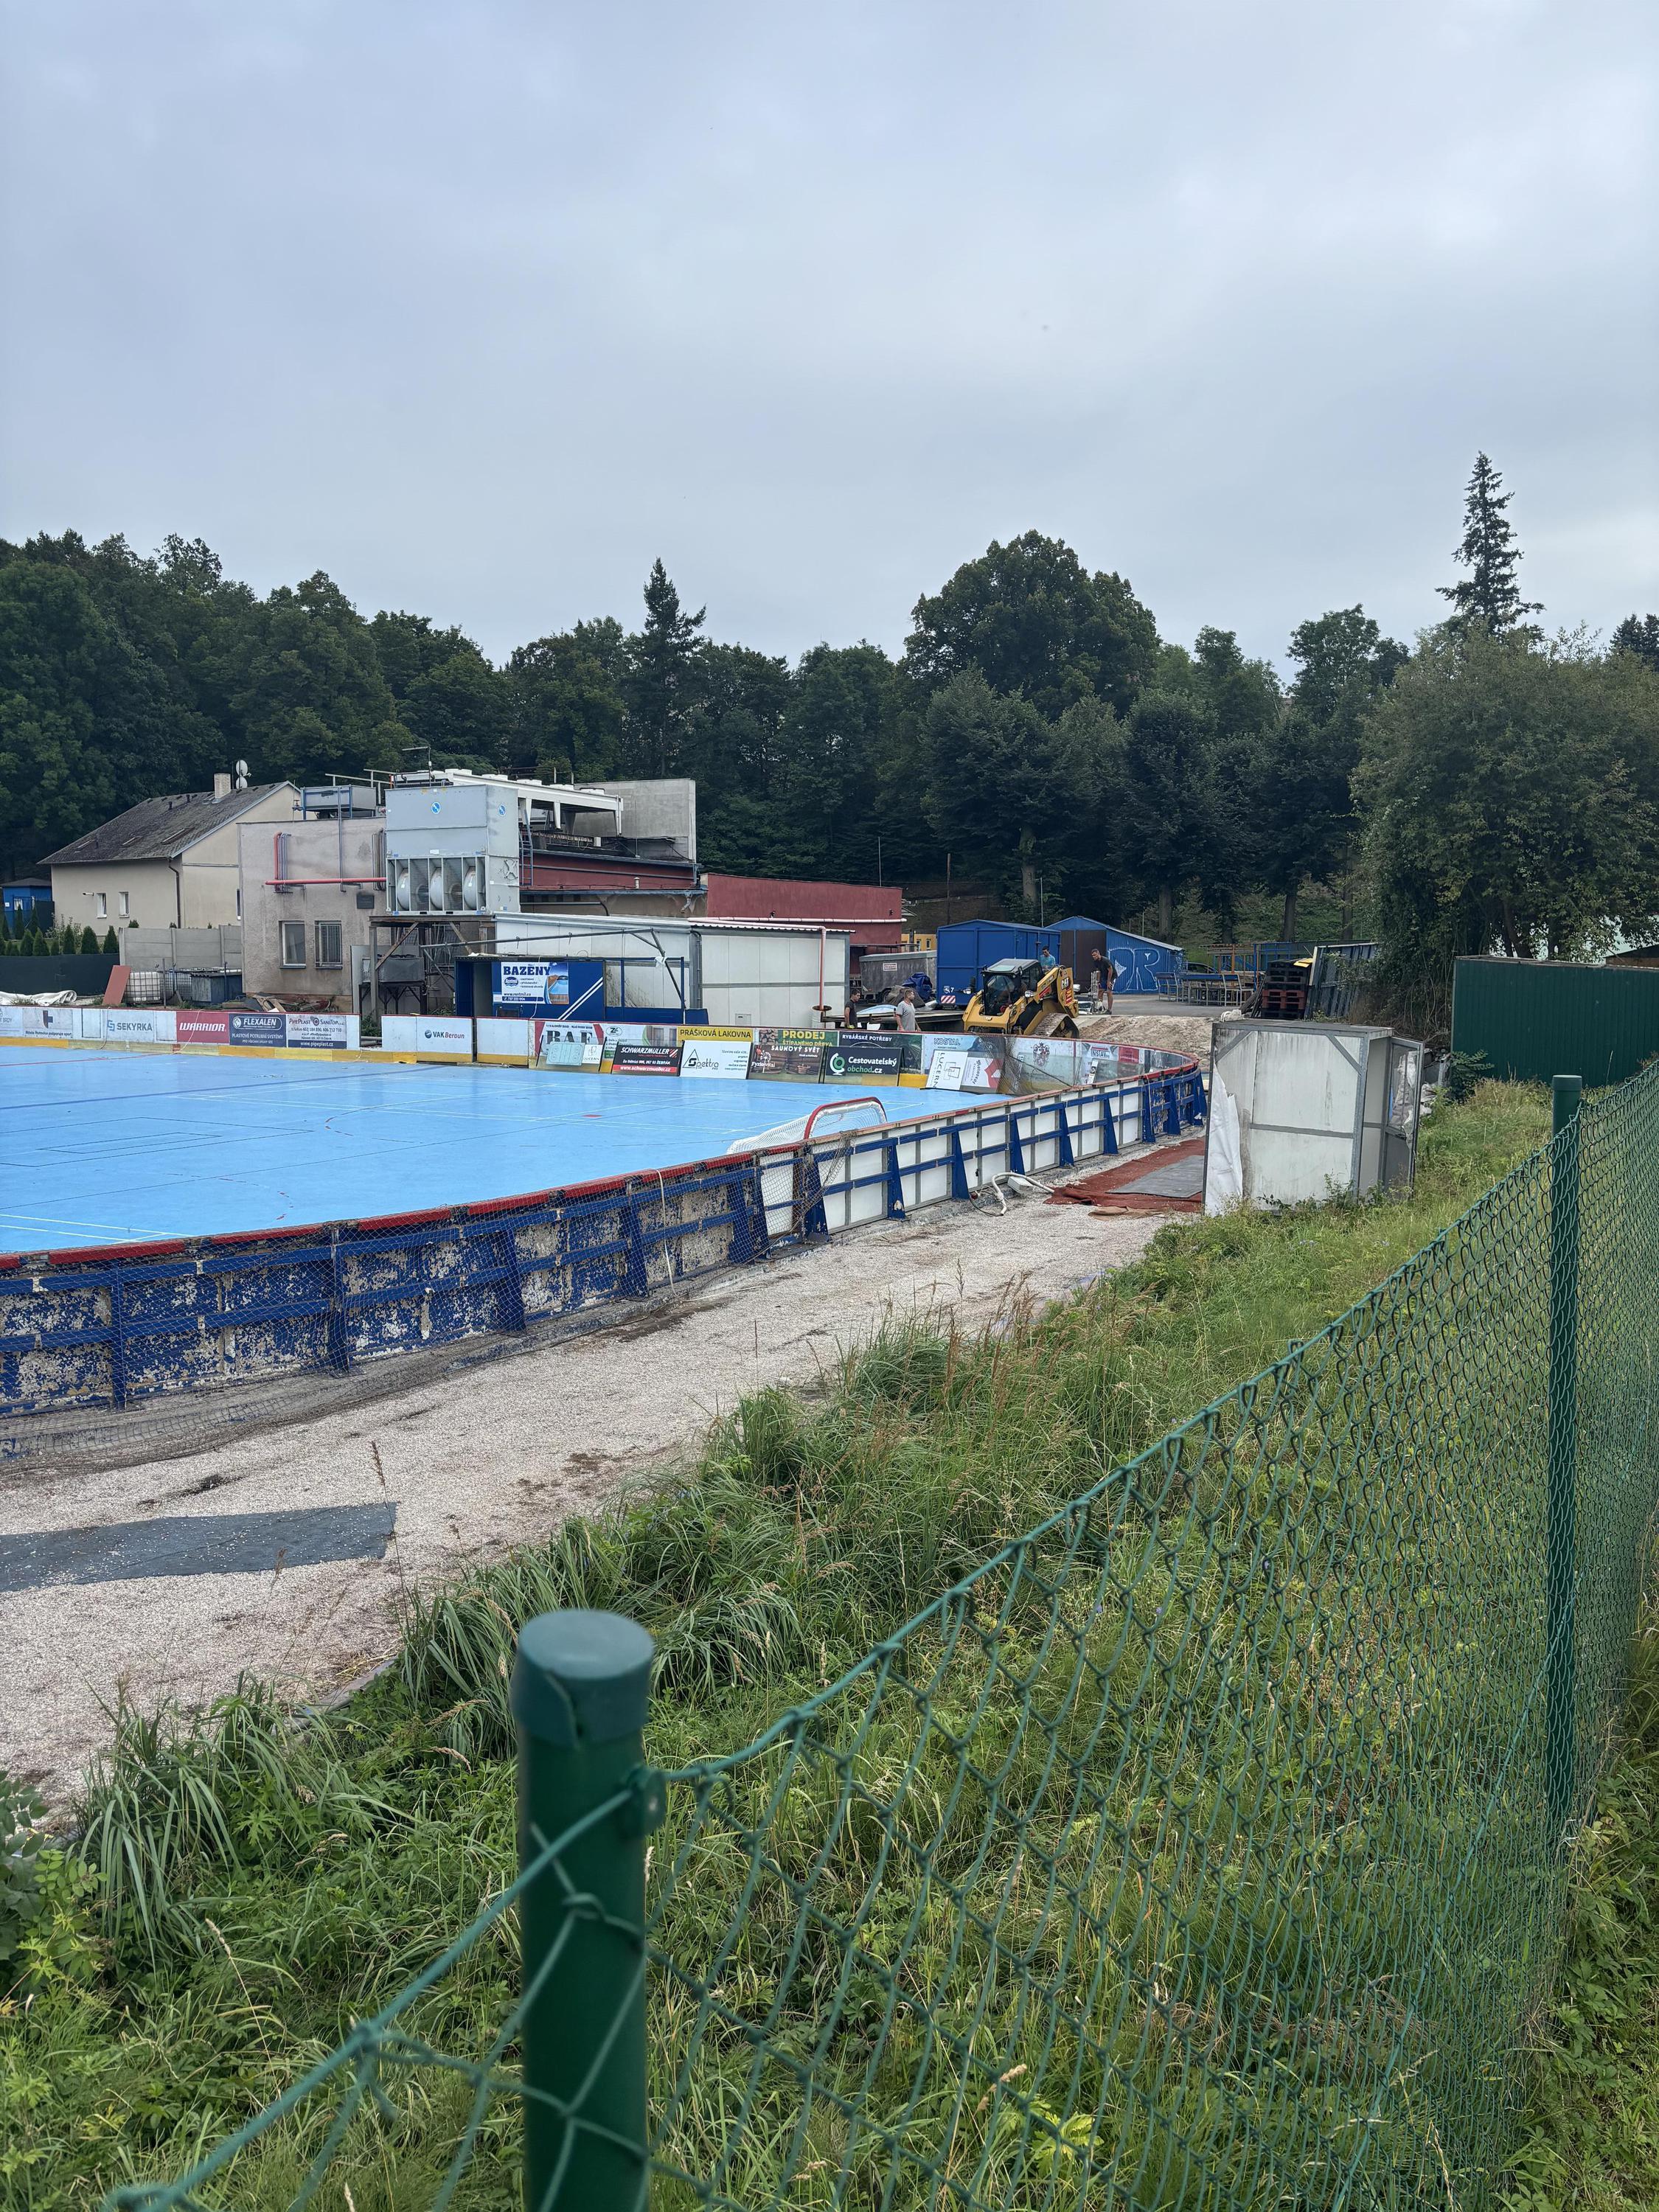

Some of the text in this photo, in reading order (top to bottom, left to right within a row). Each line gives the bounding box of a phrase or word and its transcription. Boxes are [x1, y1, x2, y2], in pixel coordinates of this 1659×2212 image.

[117, 1022, 153, 1032] SEKYRKA
[179, 1022, 226, 1032] WARRIOR
[680, 1029, 716, 1037] PRÁŠKOVÁ
[783, 1031, 824, 1040] PRODEJ
[689, 1057, 719, 1069] Spektra
[848, 1057, 897, 1067] Cestovatelský
[847, 1065, 883, 1074] obchod.cz
